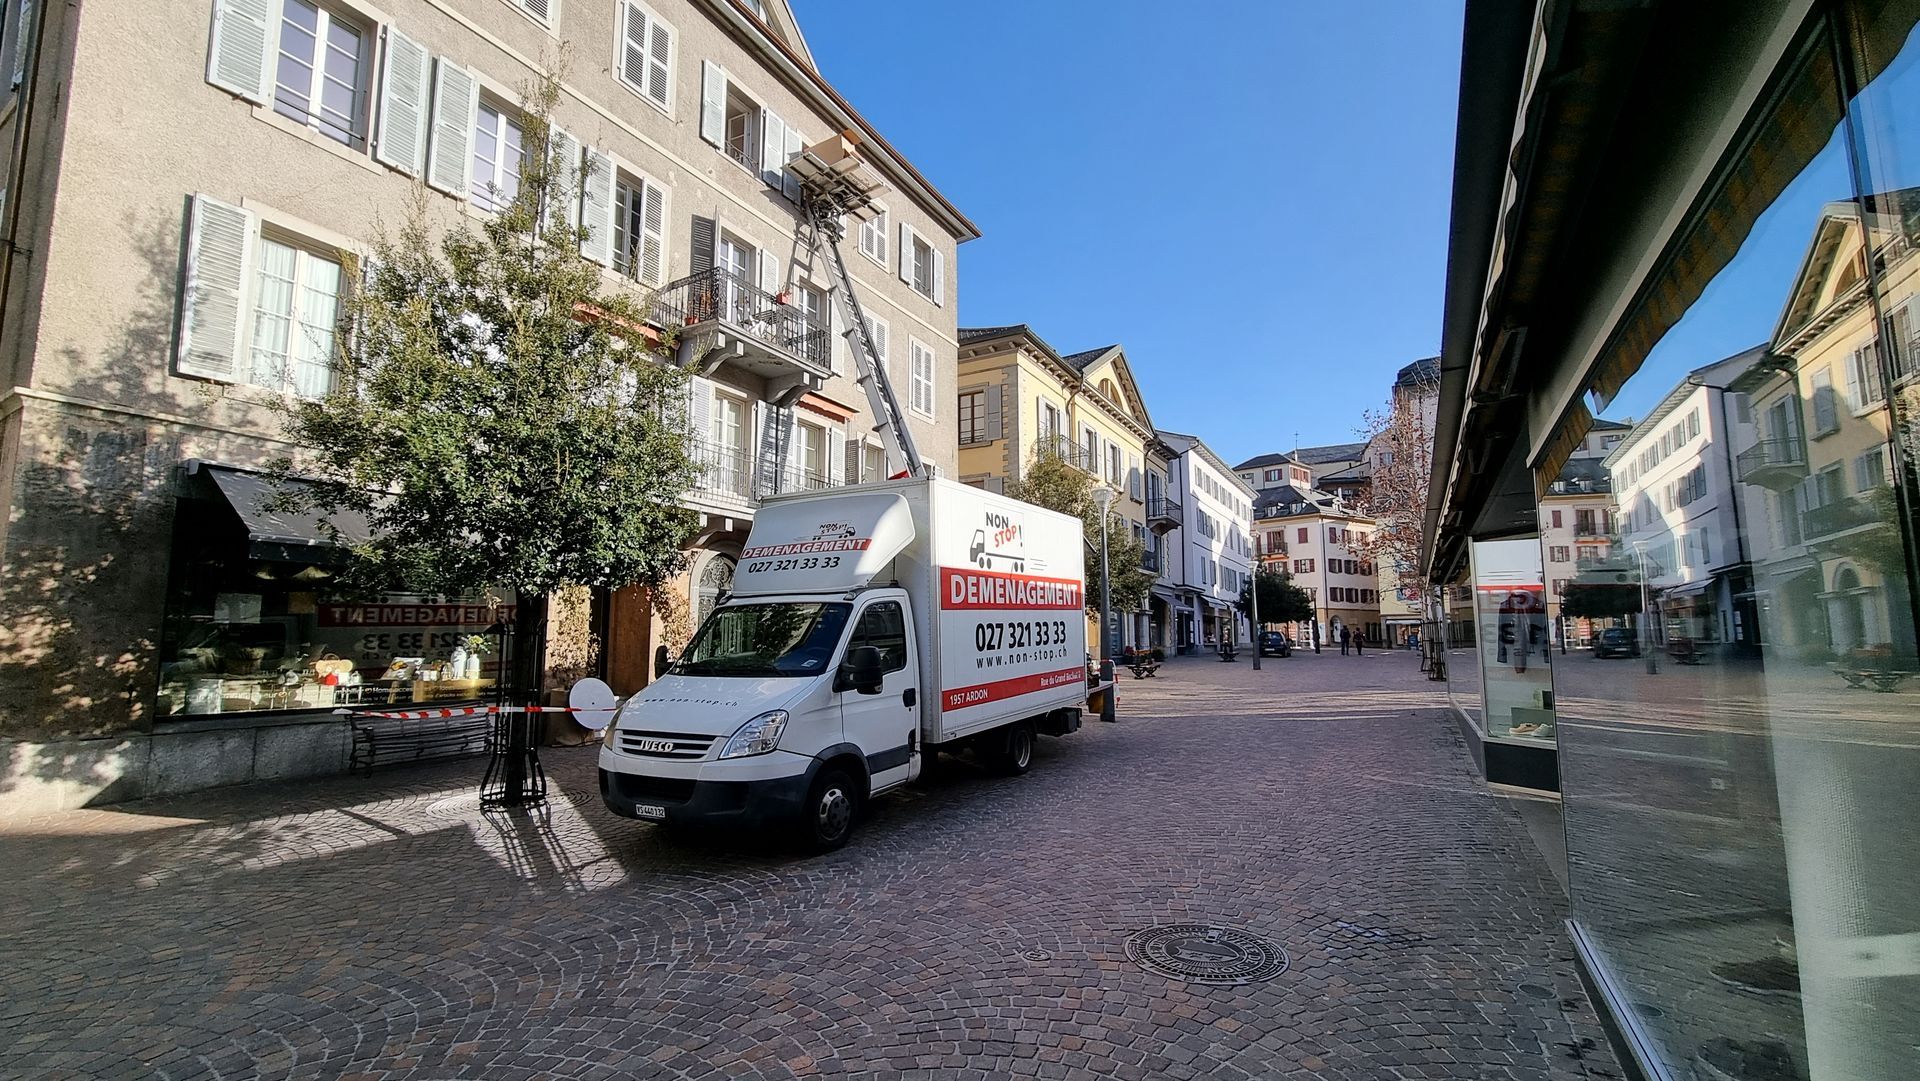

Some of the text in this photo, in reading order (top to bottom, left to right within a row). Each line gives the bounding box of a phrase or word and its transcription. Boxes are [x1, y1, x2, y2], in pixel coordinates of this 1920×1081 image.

[986, 511, 1009, 529] NON
[741, 539, 866, 559] DEMENAGEMENT
[748, 556, 841, 574] 027 321 33 33
[950, 574, 1078, 606] DEMENAGEMENT
[975, 620, 1066, 652] 027 321 33 33
[976, 645, 1068, 669] www.non-stop.ch
[950, 689, 989, 706] 1957 ARDON
[640, 740, 674, 752] IVECO
